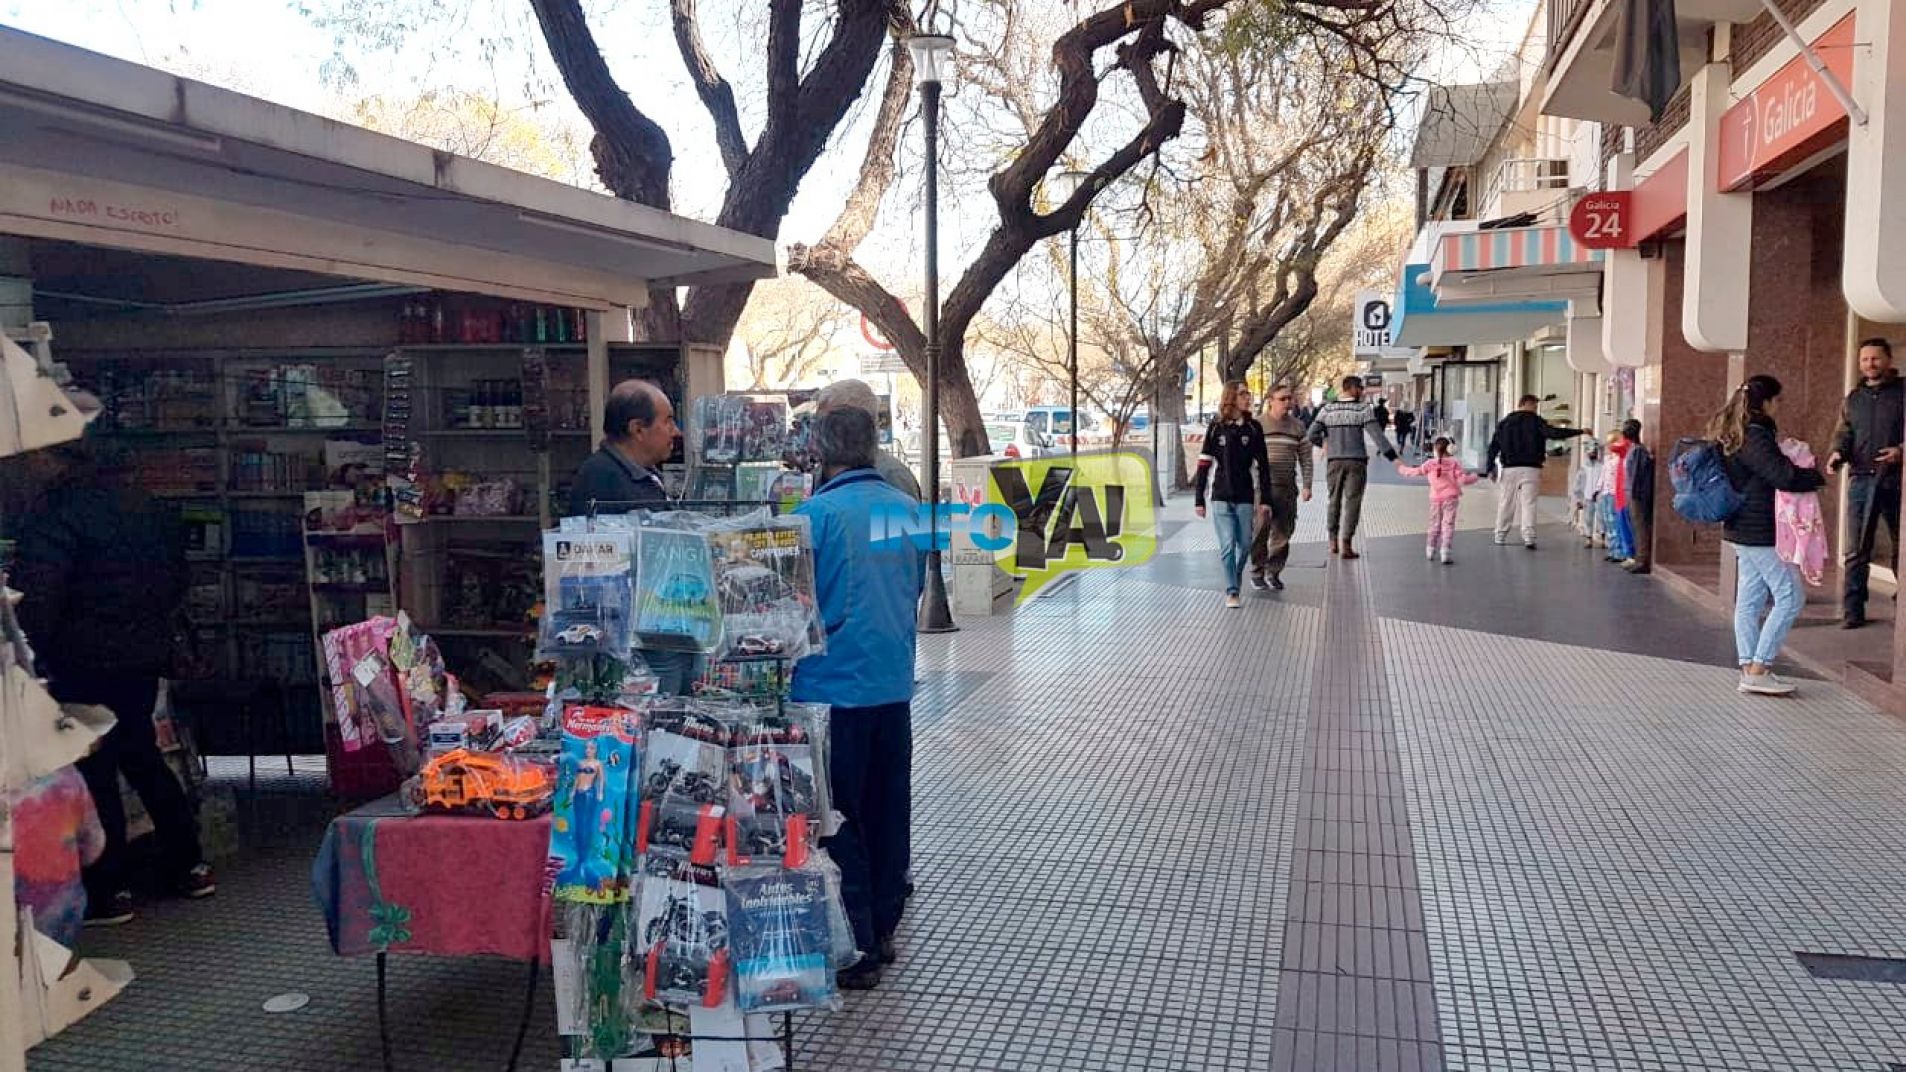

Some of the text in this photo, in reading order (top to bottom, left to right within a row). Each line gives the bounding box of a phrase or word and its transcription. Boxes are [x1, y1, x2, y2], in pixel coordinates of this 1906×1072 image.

[1764, 70, 1817, 144] Galicia
[51, 198, 97, 216] NADA
[1585, 200, 1620, 210] Galicia
[1583, 212, 1623, 238] 24
